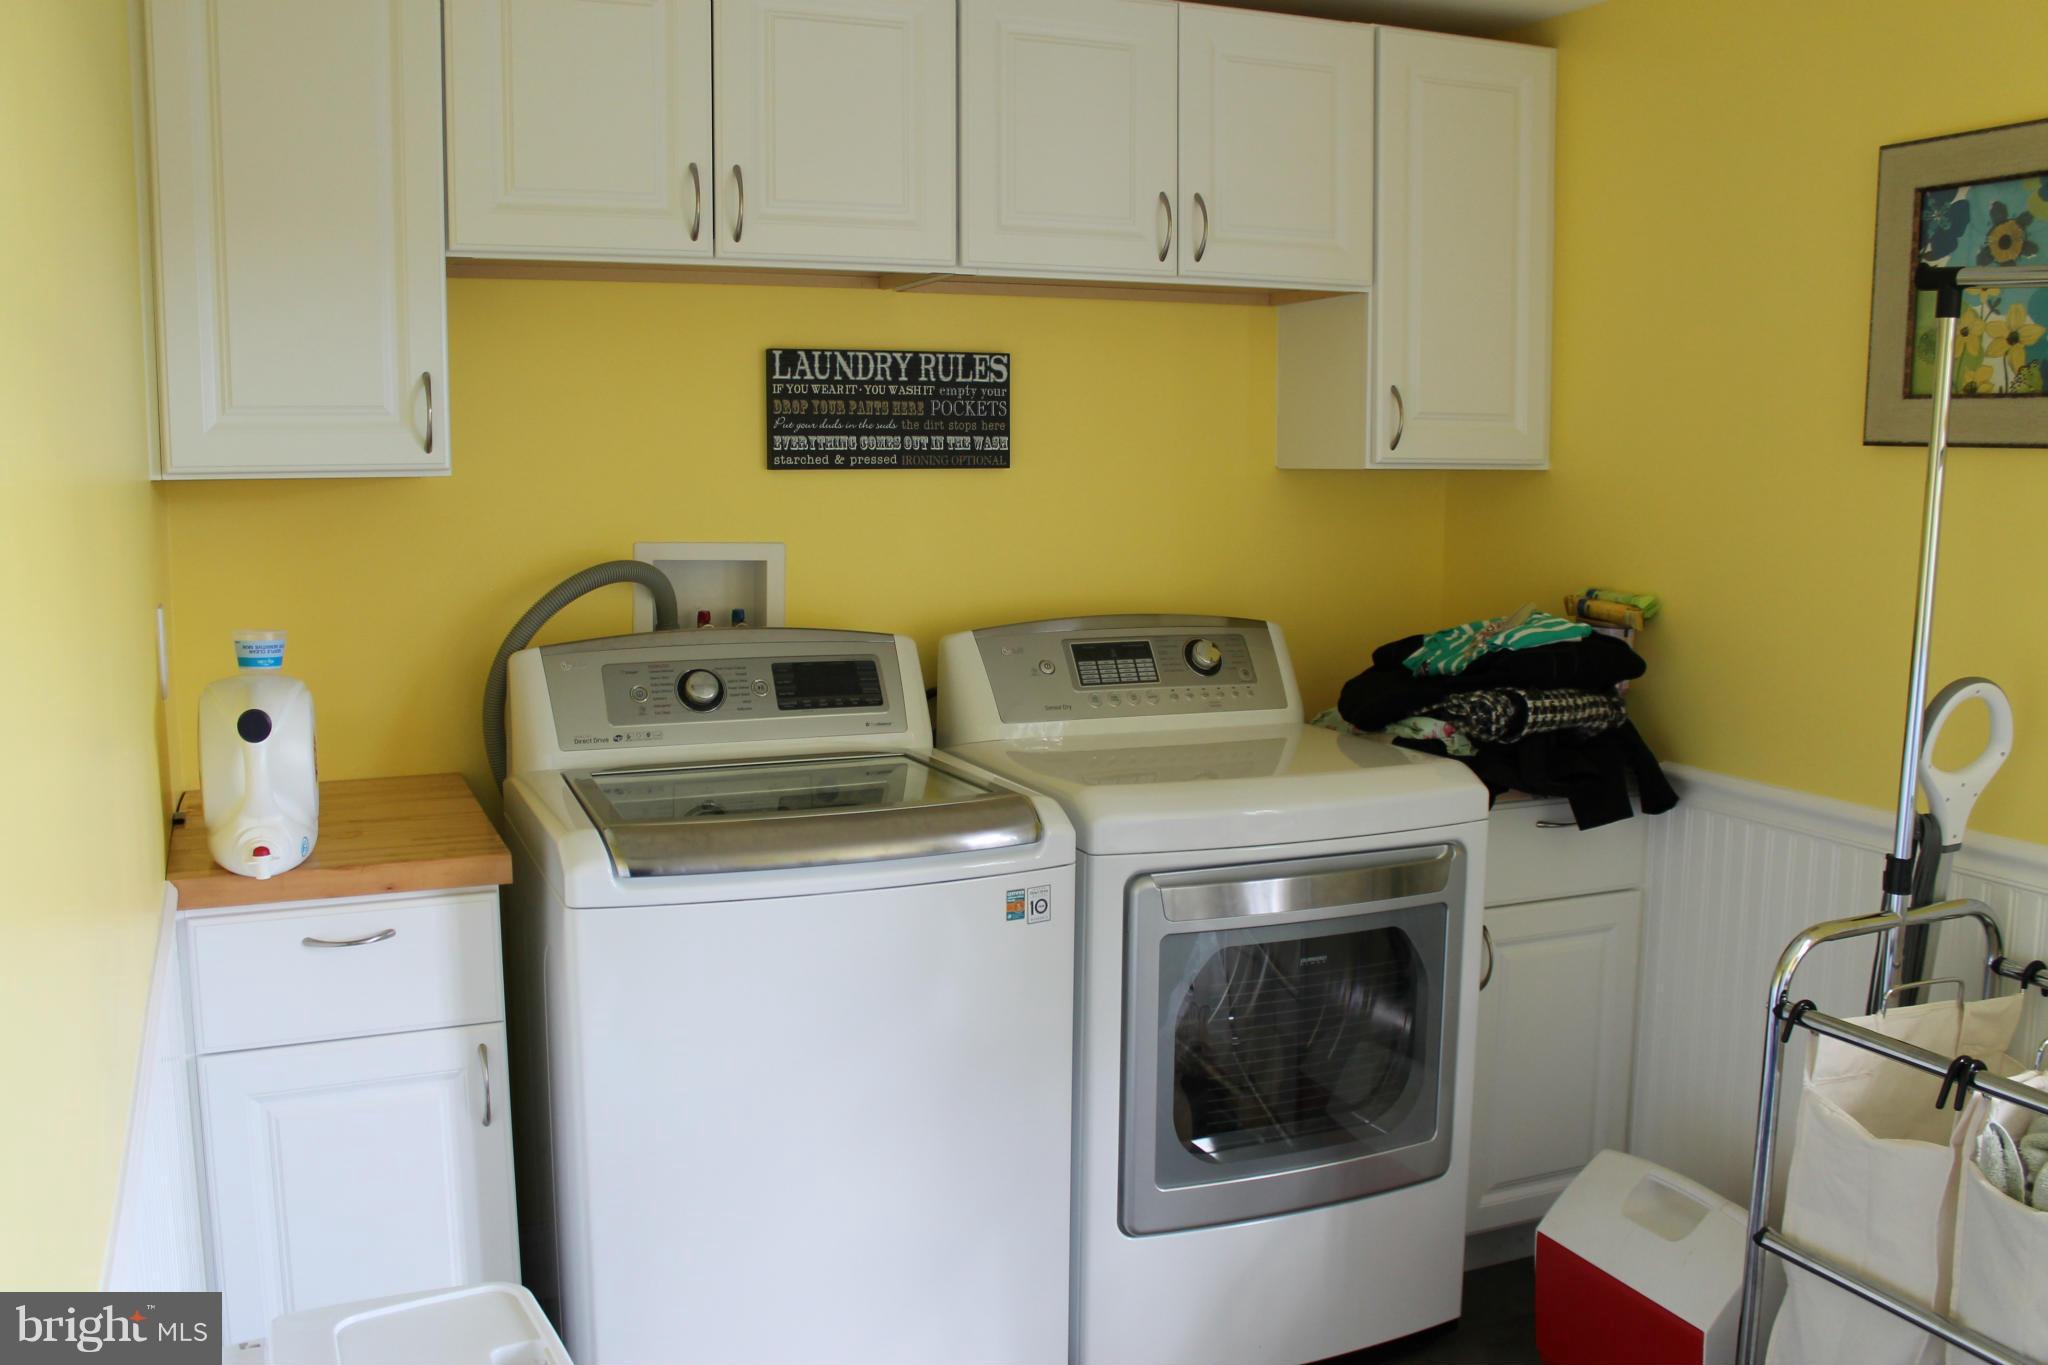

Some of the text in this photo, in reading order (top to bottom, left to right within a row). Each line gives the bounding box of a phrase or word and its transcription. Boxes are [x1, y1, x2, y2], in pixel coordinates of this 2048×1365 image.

[772, 350, 1008, 383] LAUNDRY RULES
[772, 384, 784, 394] IF
[786, 384, 809, 394] YOU
[864, 385, 886, 395] YOU
[939, 385, 1008, 400] empty your
[773, 400, 925, 416] DROP YOUR PANTS HERE
[930, 400, 1007, 417] POCKETS
[773, 416, 898, 433] Put your duds in the suds
[901, 419, 1006, 432] the dirt stops here
[773, 435, 1009, 450] EVERYTHING COMES OUT IN THE WASH
[773, 454, 897, 467] starched & pressed
[901, 455, 1007, 466] IRONING OPTIONAL
[574, 737, 592, 745] Direct
